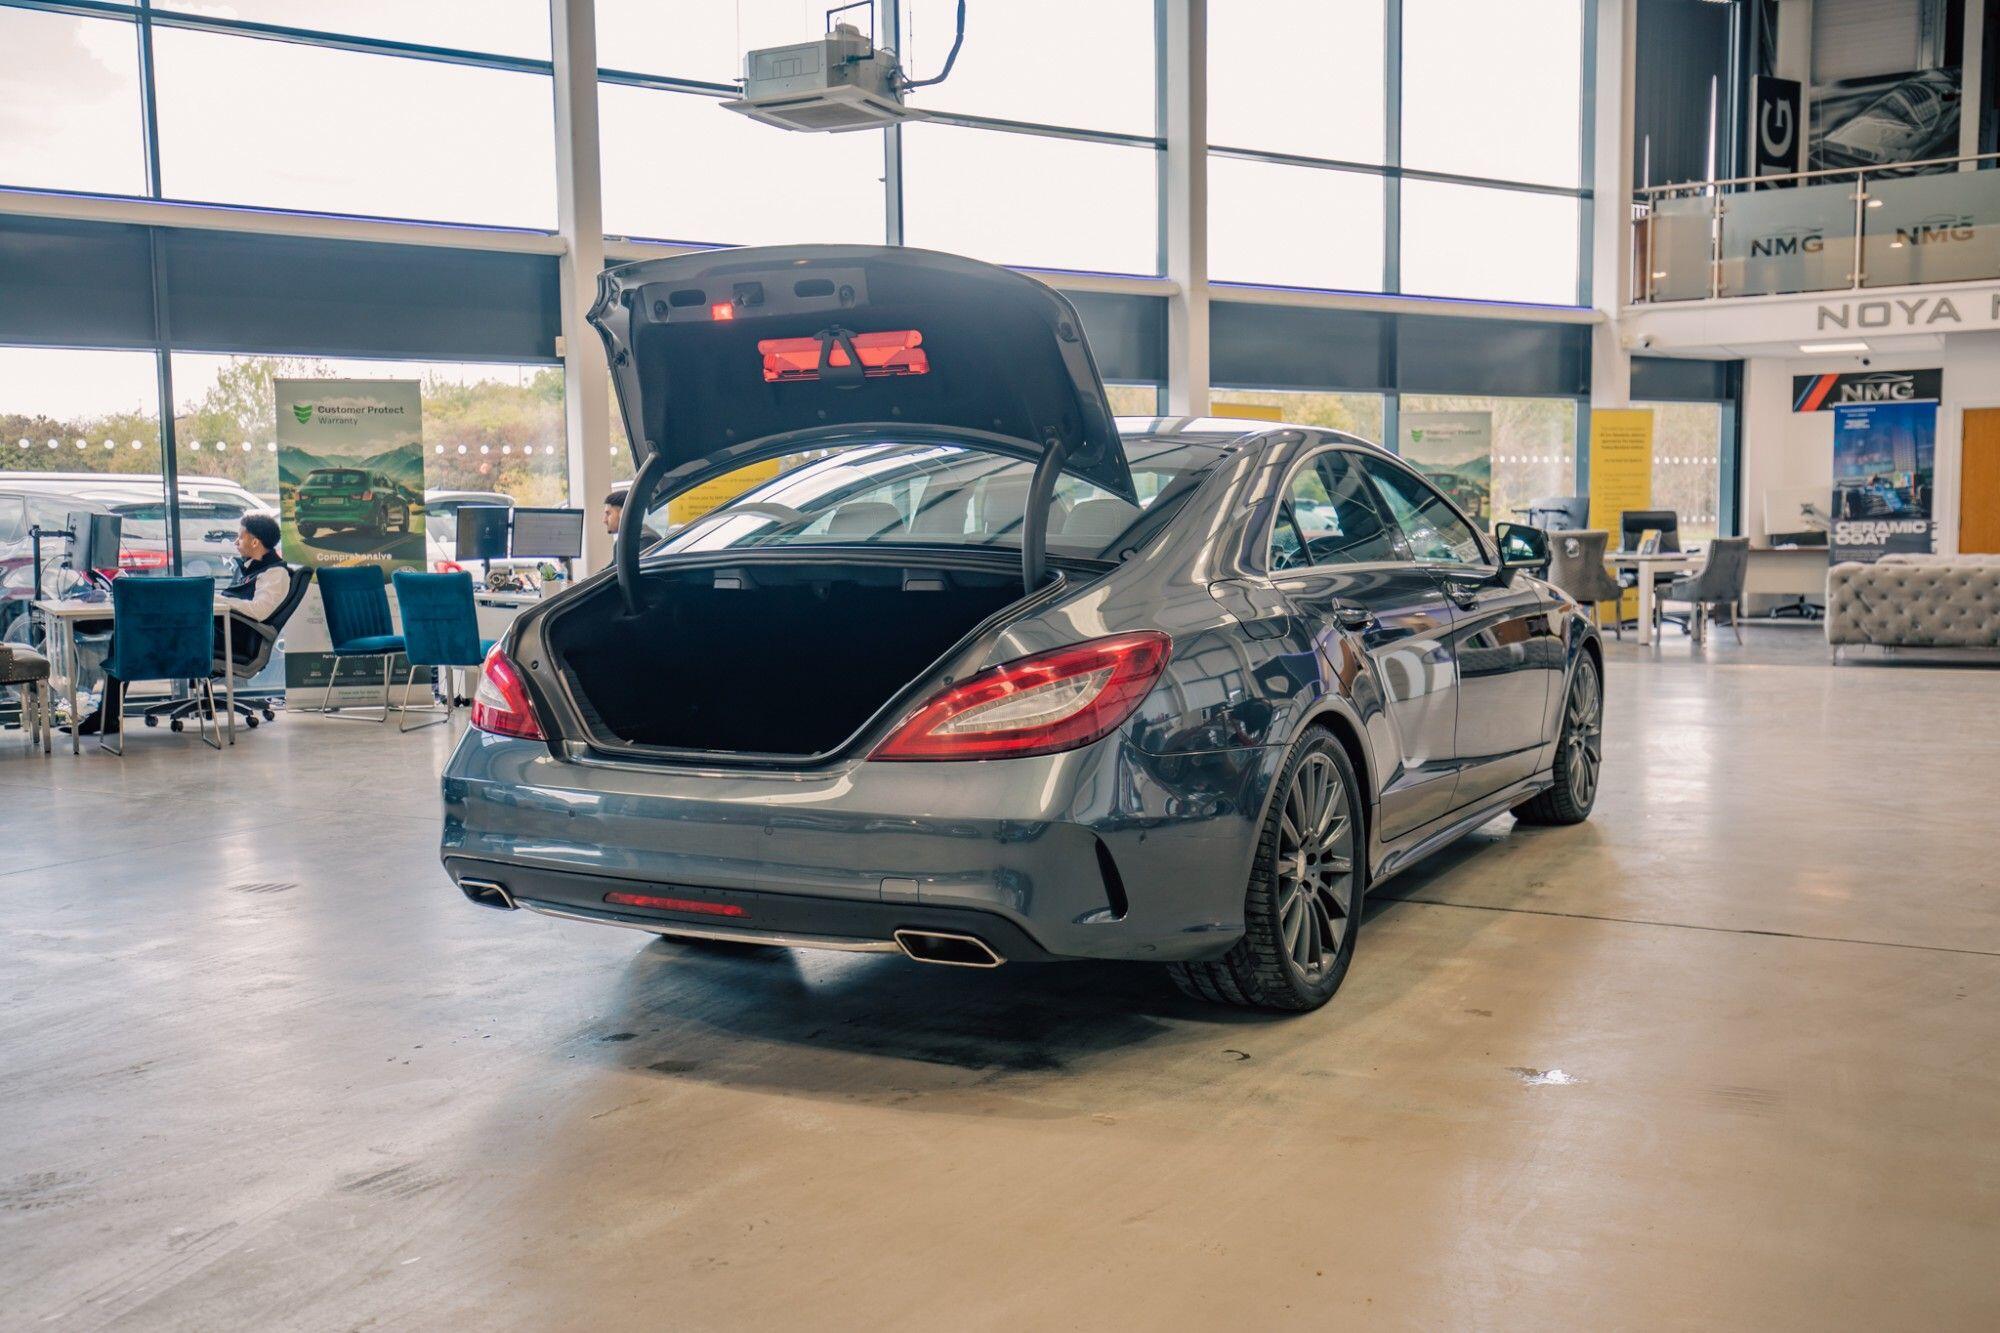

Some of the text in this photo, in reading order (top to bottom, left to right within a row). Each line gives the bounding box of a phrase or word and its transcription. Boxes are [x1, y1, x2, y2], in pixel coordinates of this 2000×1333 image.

[1896, 222, 1975, 246] NMG
[1751, 234, 1824, 258] NMG
[1817, 297, 1962, 331] NOYA
[1840, 381, 1914, 403] NMG
[318, 405, 405, 414] Customer Protect
[318, 417, 359, 426] Warranty
[1835, 521, 1927, 534] CERAMIC
[1835, 532, 1891, 545] COAT
[316, 552, 393, 562] Comprehensive
